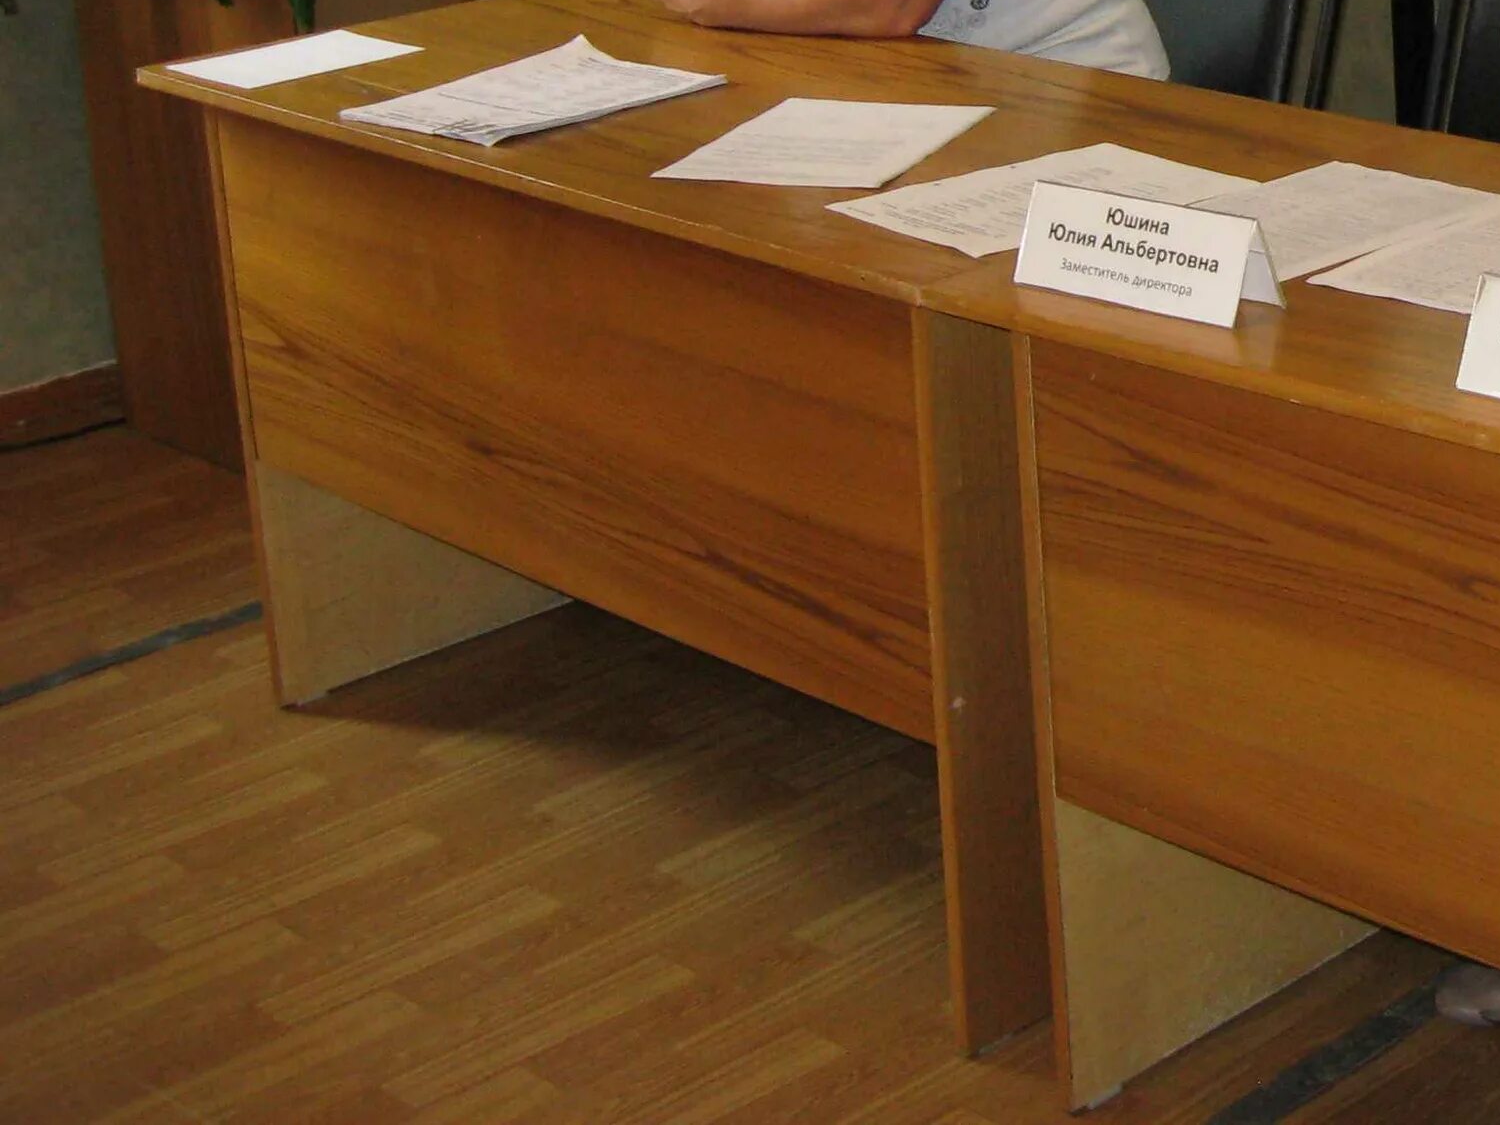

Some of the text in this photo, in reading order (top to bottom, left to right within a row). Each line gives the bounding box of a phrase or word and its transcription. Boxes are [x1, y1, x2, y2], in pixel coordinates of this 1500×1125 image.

[1106, 207, 1170, 236] Юшина
[1048, 222, 1220, 274] Юлия Альбертовна
[1060, 257, 1193, 298] Заместитель директора
